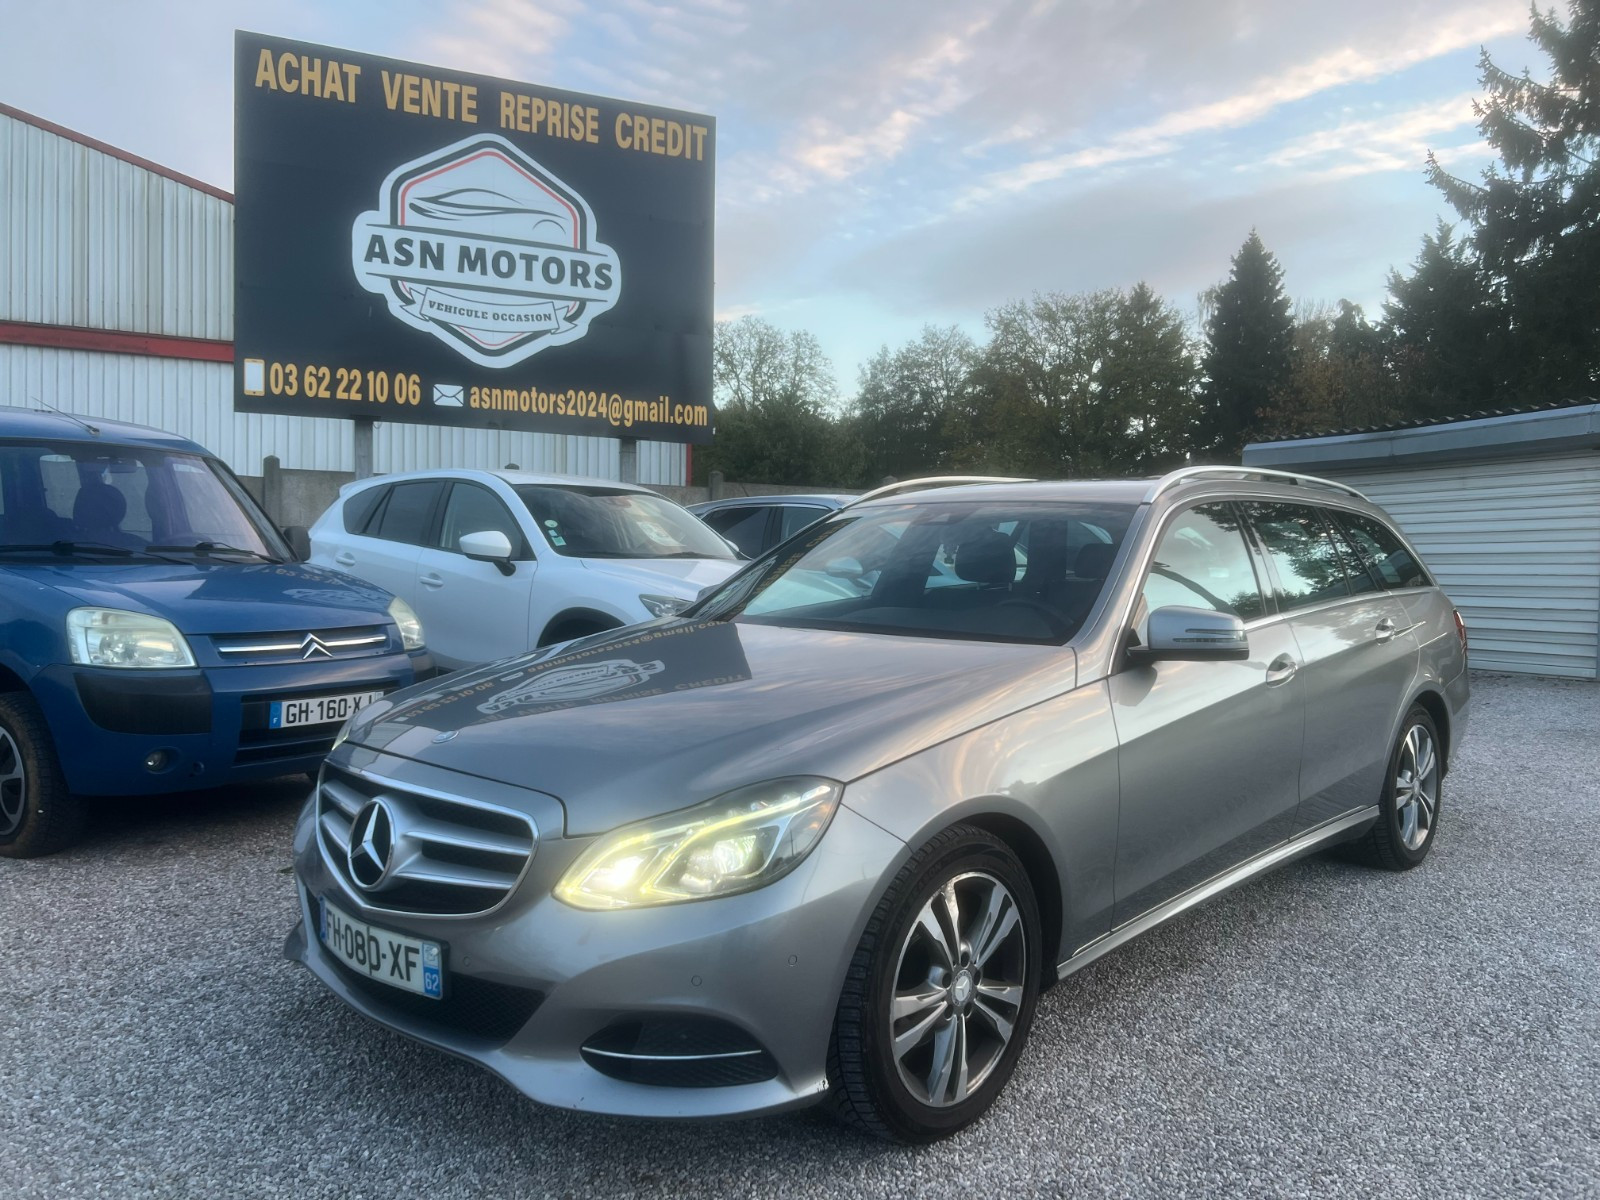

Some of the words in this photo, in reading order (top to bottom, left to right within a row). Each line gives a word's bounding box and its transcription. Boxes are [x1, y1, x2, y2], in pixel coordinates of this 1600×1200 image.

[255, 48, 361, 103] ACHAT
[381, 70, 478, 123] VENTE
[500, 92, 600, 144] REPRISE
[615, 113, 707, 161] CREDIT
[364, 234, 445, 271] ASN
[457, 245, 613, 291] MOTORS
[428, 300, 489, 320] VEHICULE
[492, 312, 552, 322] OCCASION
[269, 362, 298, 396] 03
[303, 365, 331, 398] 62
[336, 368, 362, 401] 22
[367, 371, 389, 403] 10
[394, 373, 421, 406] 06
[470, 384, 708, 428] asnmotors2024@gmail.com
[286, 694, 373, 724] GH-160-X
[326, 908, 420, 982] FH-080-XF
[425, 972, 439, 991] 62
